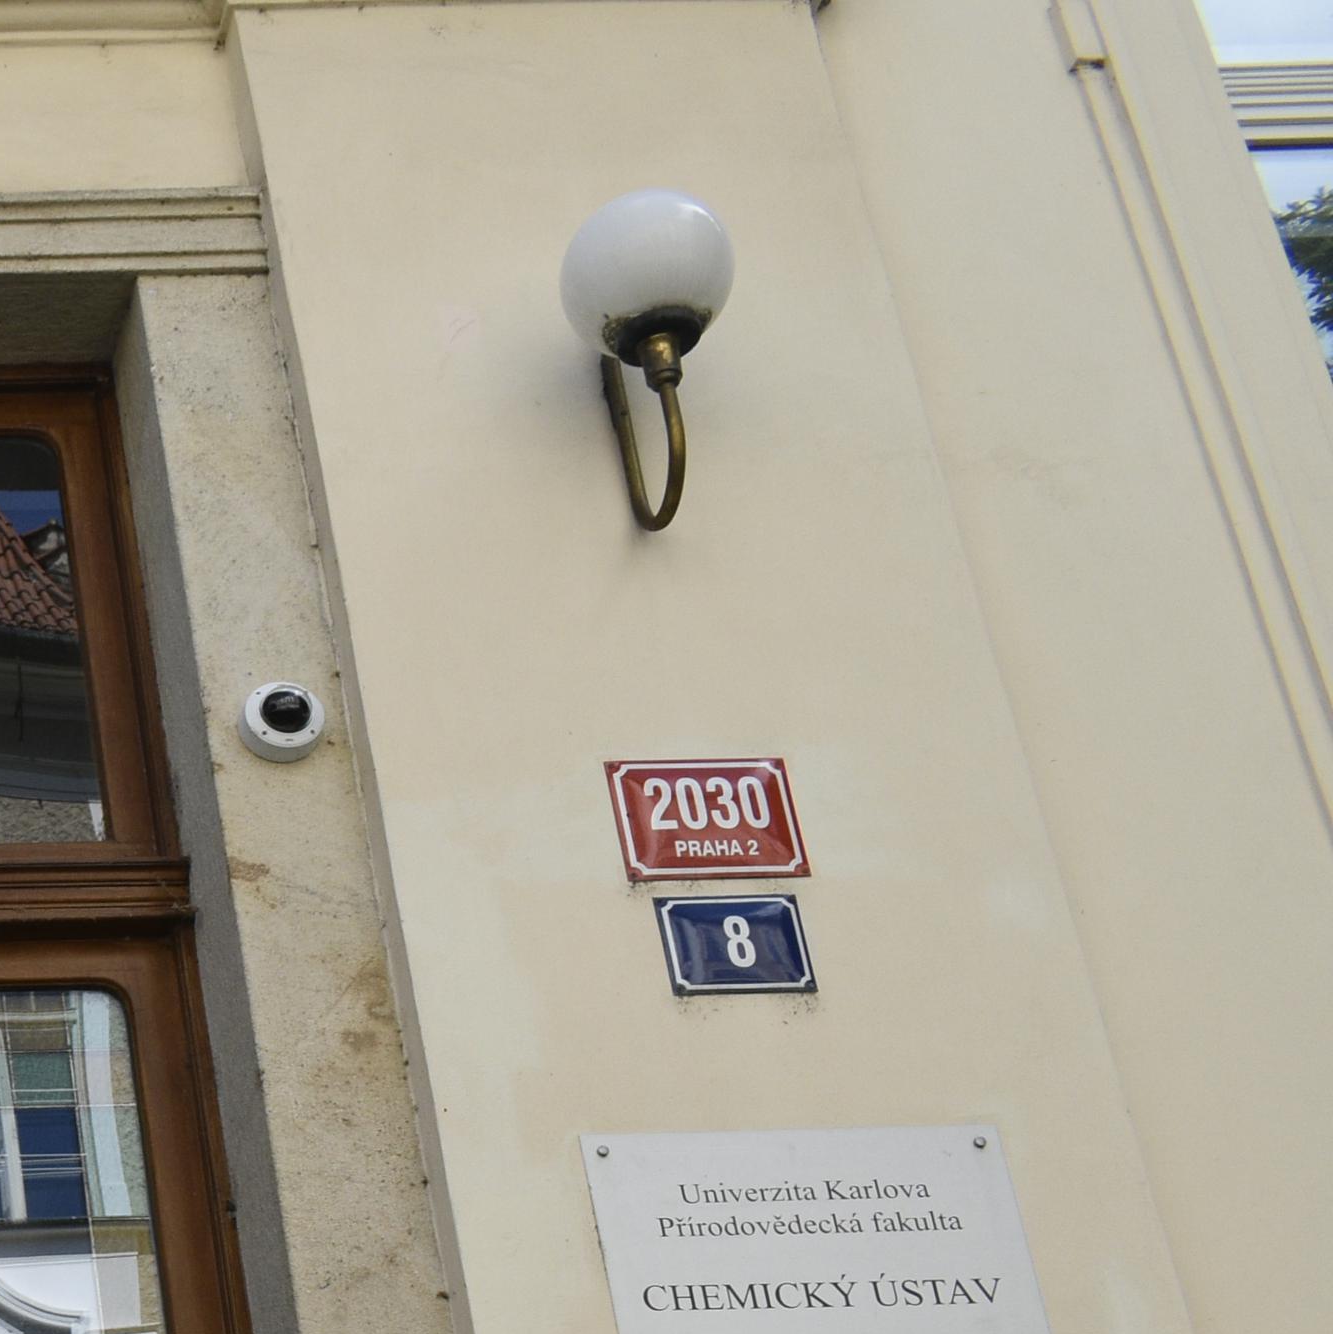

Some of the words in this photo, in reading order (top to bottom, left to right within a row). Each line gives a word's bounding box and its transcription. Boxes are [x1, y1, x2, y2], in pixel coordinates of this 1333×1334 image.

[643, 774, 771, 832] 2030
[674, 839, 743, 858] PRAHA
[746, 838, 760, 857] 2
[723, 914, 758, 969] 8
[678, 1181, 817, 1206] Univerzita
[824, 1178, 931, 1203] Karlova
[658, 1212, 864, 1239] Přírodovědecká
[872, 1209, 964, 1234] fakulta
[642, 1274, 857, 1313] CHEMICKÝ
[873, 1272, 1003, 1308] ÚSTAV
